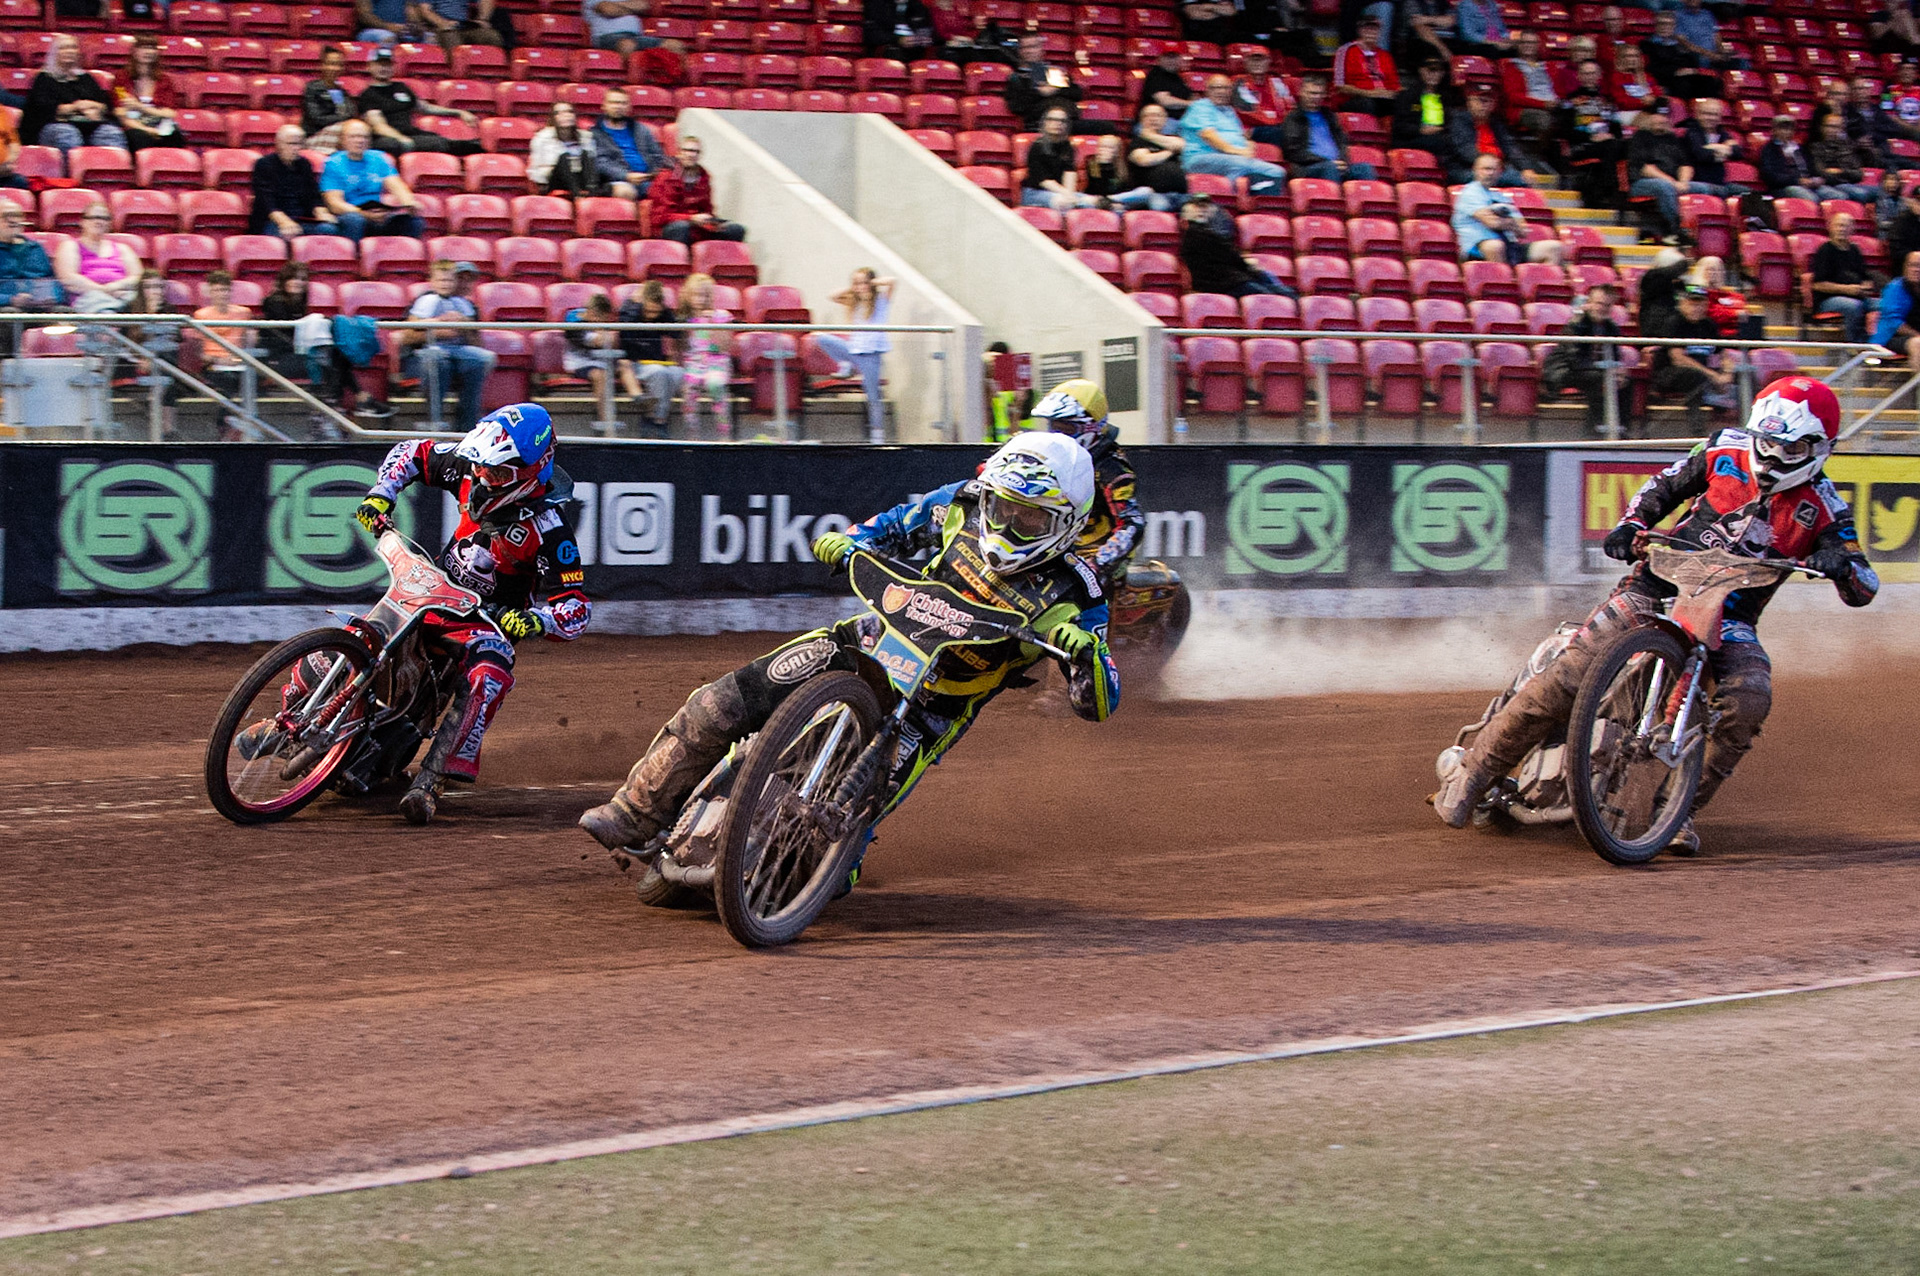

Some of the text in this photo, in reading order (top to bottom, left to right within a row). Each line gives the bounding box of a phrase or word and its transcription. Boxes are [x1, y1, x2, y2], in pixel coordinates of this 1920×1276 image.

[1799, 507, 1815, 520] 4
[510, 528, 524, 544] 6
[444, 554, 495, 596] COLTS
[984, 570, 1036, 613] WEBSTER
[911, 593, 974, 627] Chiltern
